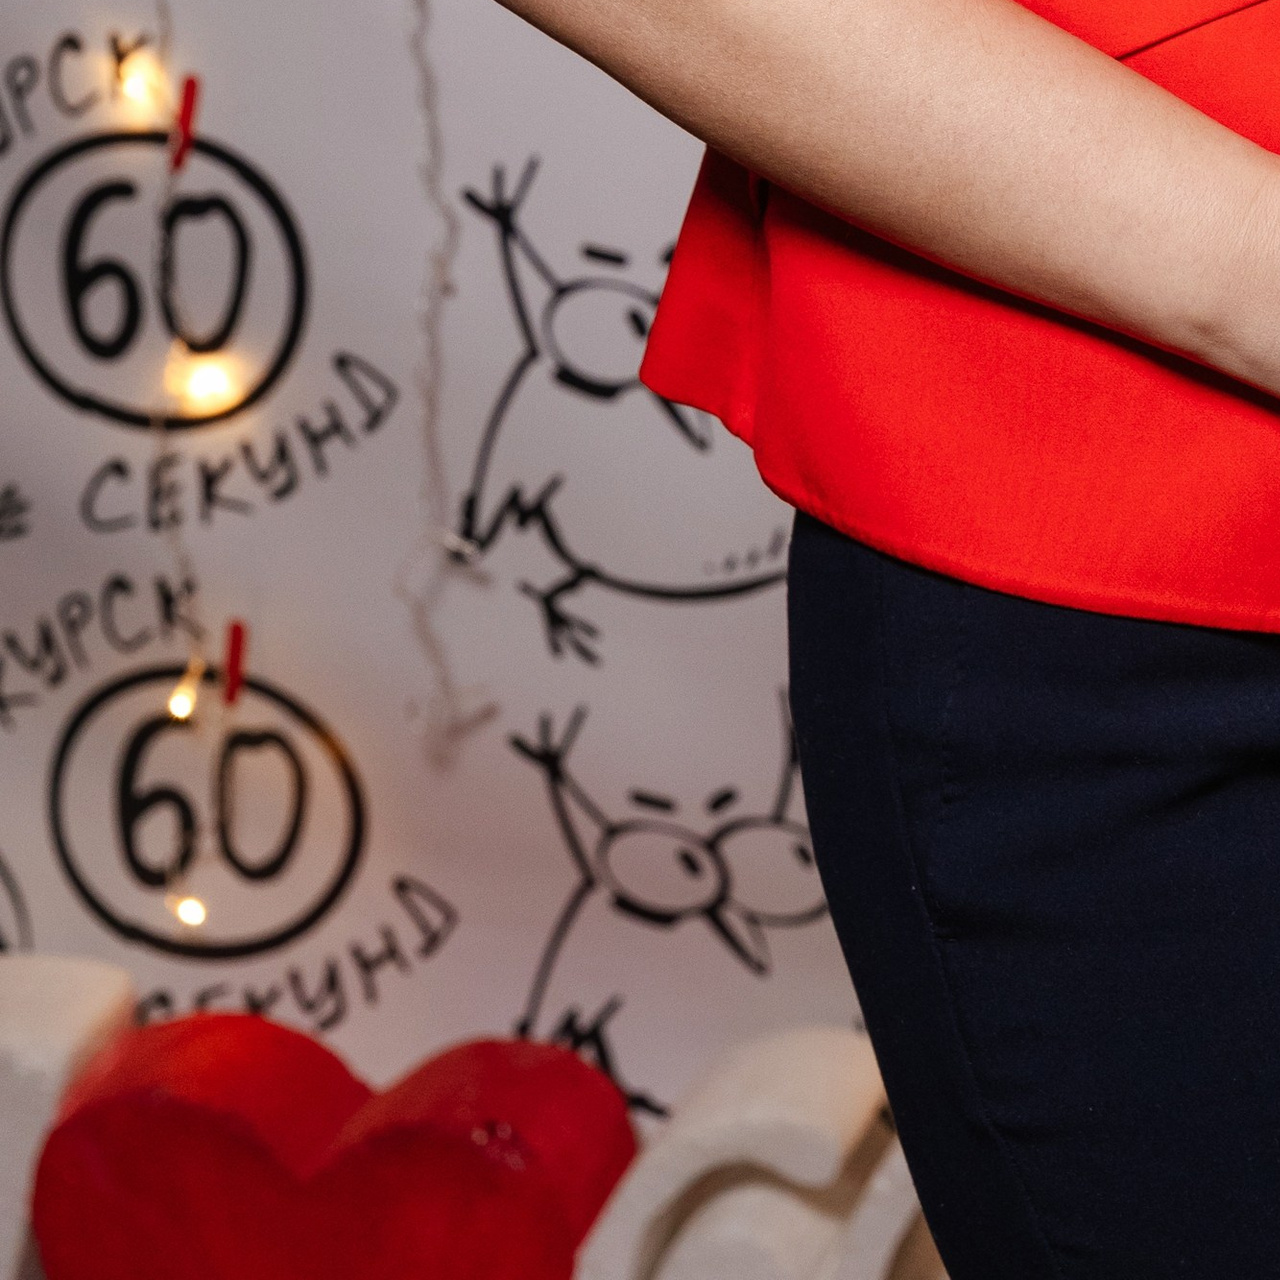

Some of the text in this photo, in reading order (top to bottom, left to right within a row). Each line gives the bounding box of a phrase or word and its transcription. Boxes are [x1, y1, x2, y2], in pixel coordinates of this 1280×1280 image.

[62, 180, 250, 360] 60
[80, 349, 398, 534] СЕКУНД
[116, 713, 307, 887] 60
